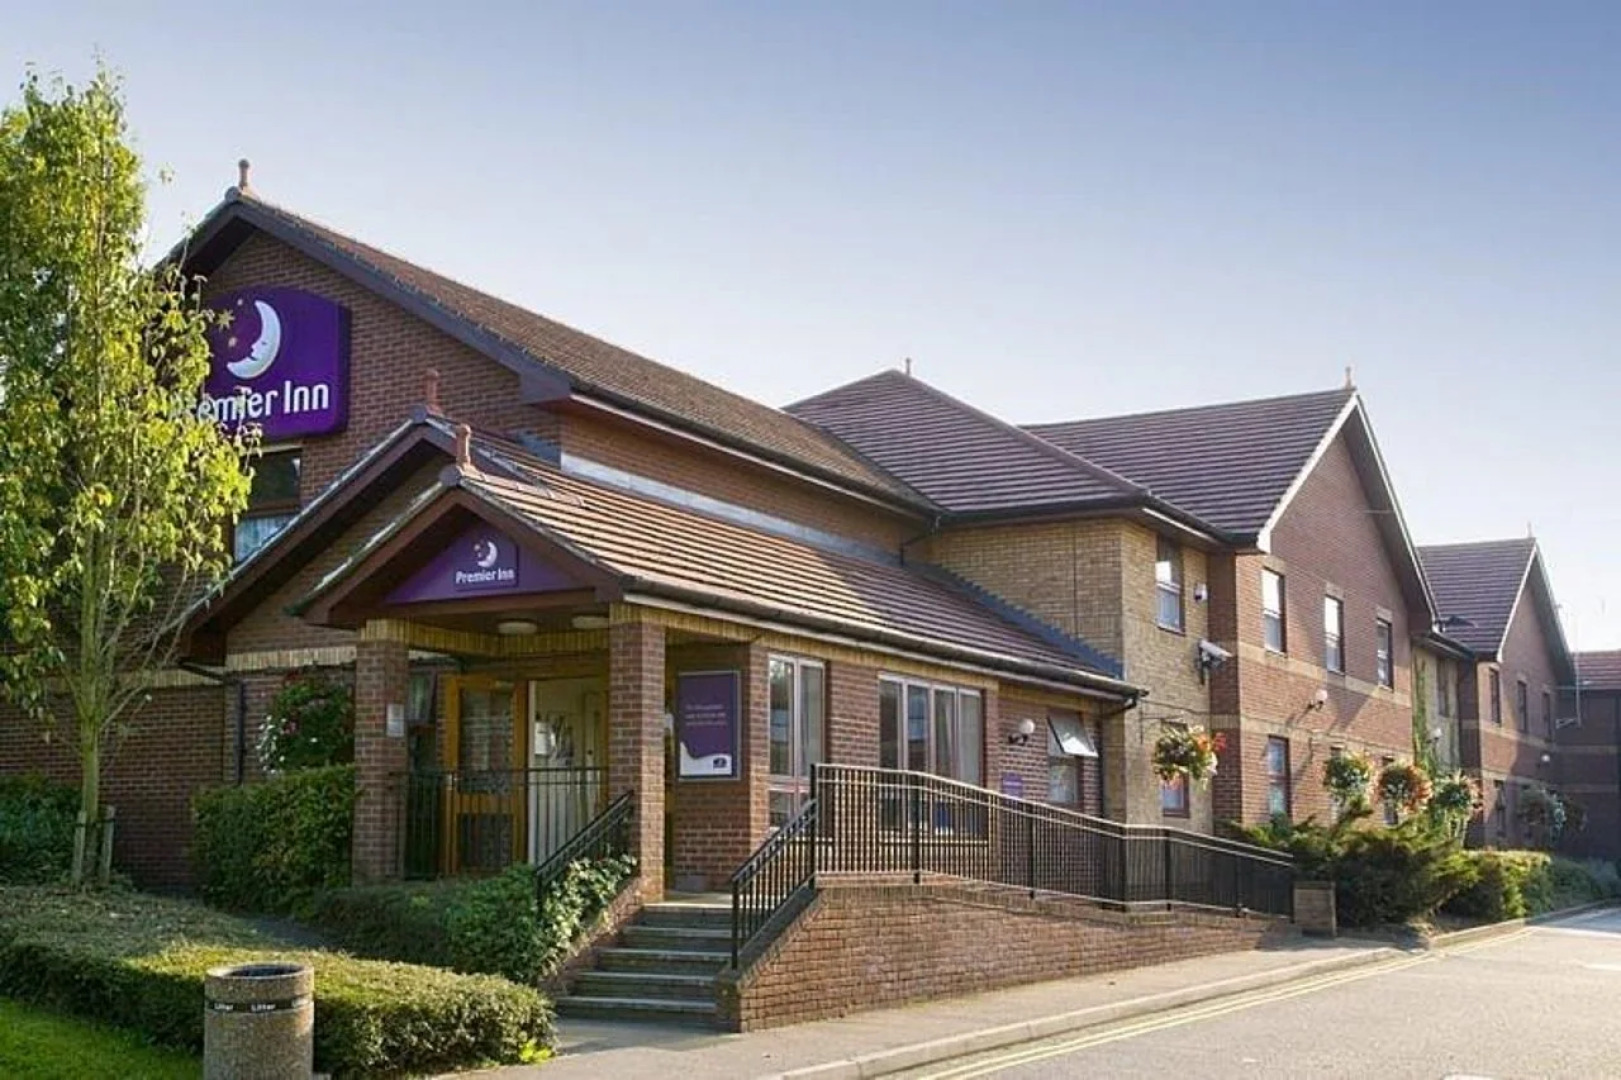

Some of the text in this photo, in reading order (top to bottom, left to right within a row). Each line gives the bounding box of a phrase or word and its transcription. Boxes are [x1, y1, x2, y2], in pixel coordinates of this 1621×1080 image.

[171, 380, 329, 421] emier Inn
[455, 567, 515, 584] Premier Inn
